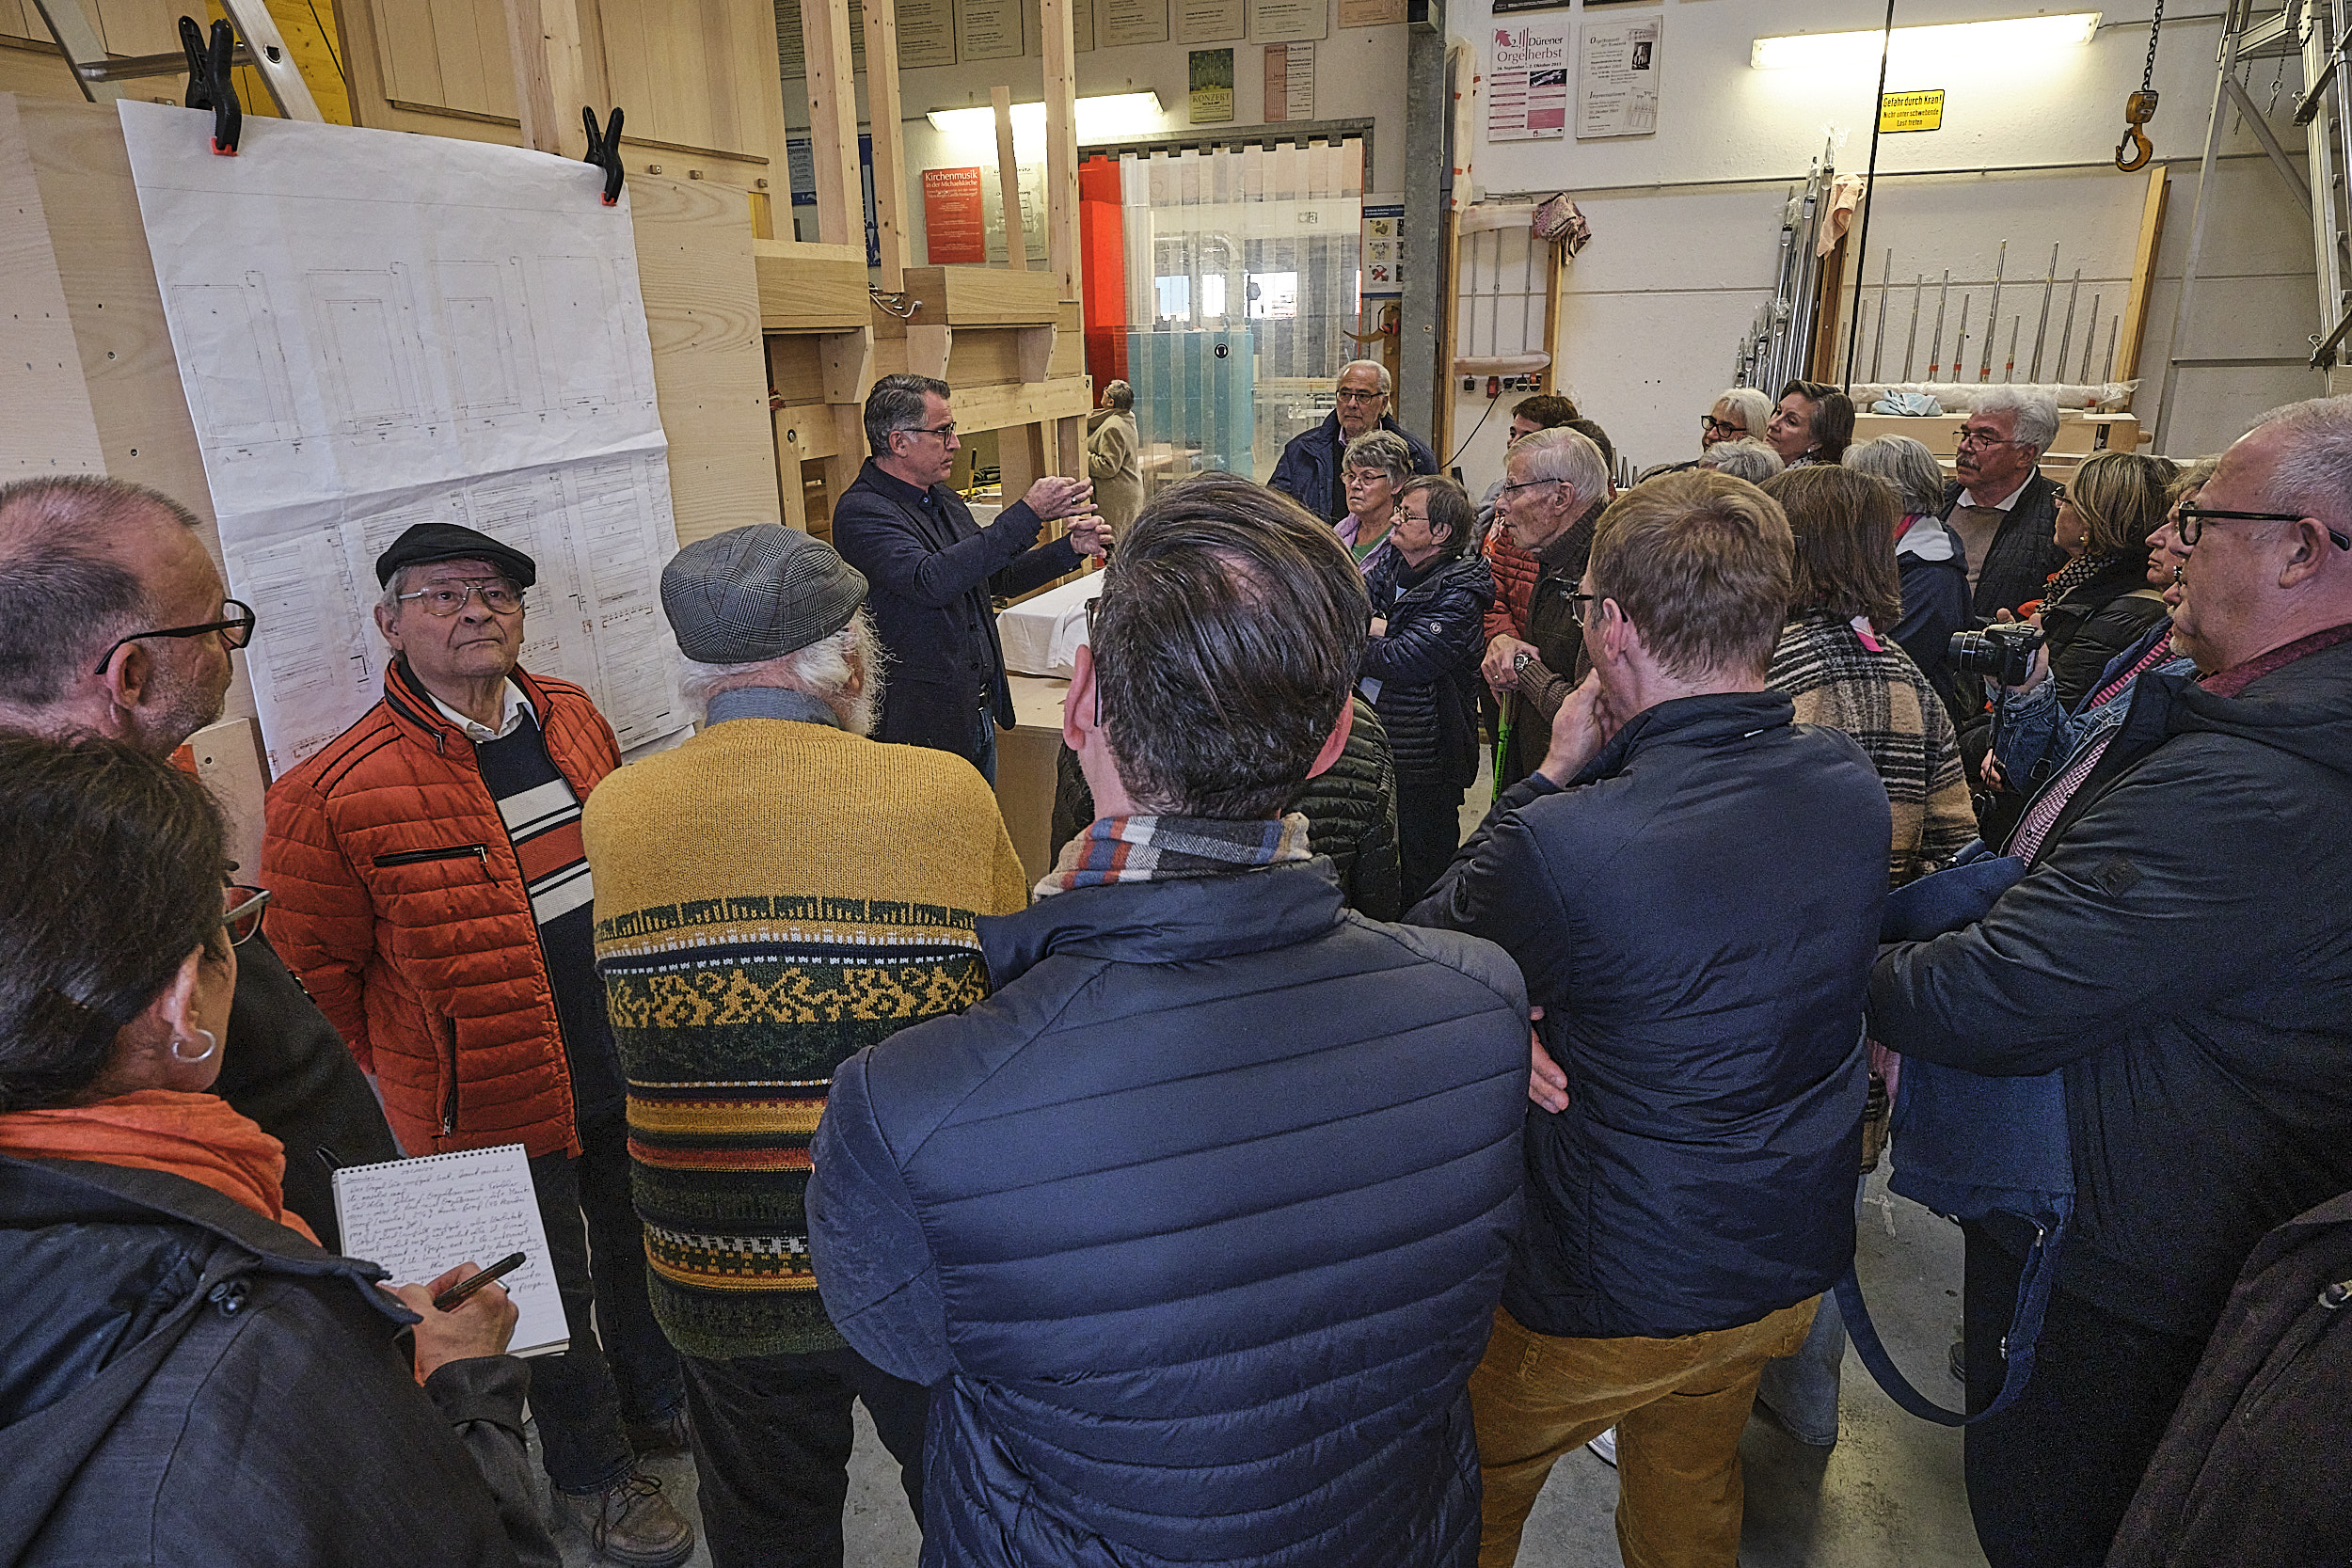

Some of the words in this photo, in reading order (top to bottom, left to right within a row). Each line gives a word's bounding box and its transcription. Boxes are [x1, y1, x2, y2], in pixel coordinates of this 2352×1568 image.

[1511, 39, 1518, 48] 2.
[1528, 37, 1564, 46] Dürener
[1497, 47, 1562, 64] Orgelherbst
[1192, 93, 1230, 103] KONZERT
[1883, 97, 1904, 107] Gefahr
[1904, 96, 1923, 106] durch
[1924, 94, 1943, 104] Kran!
[1910, 108, 1939, 117] schwebende
[925, 169, 977, 182] Kirchenmusik
[931, 180, 940, 188] der
